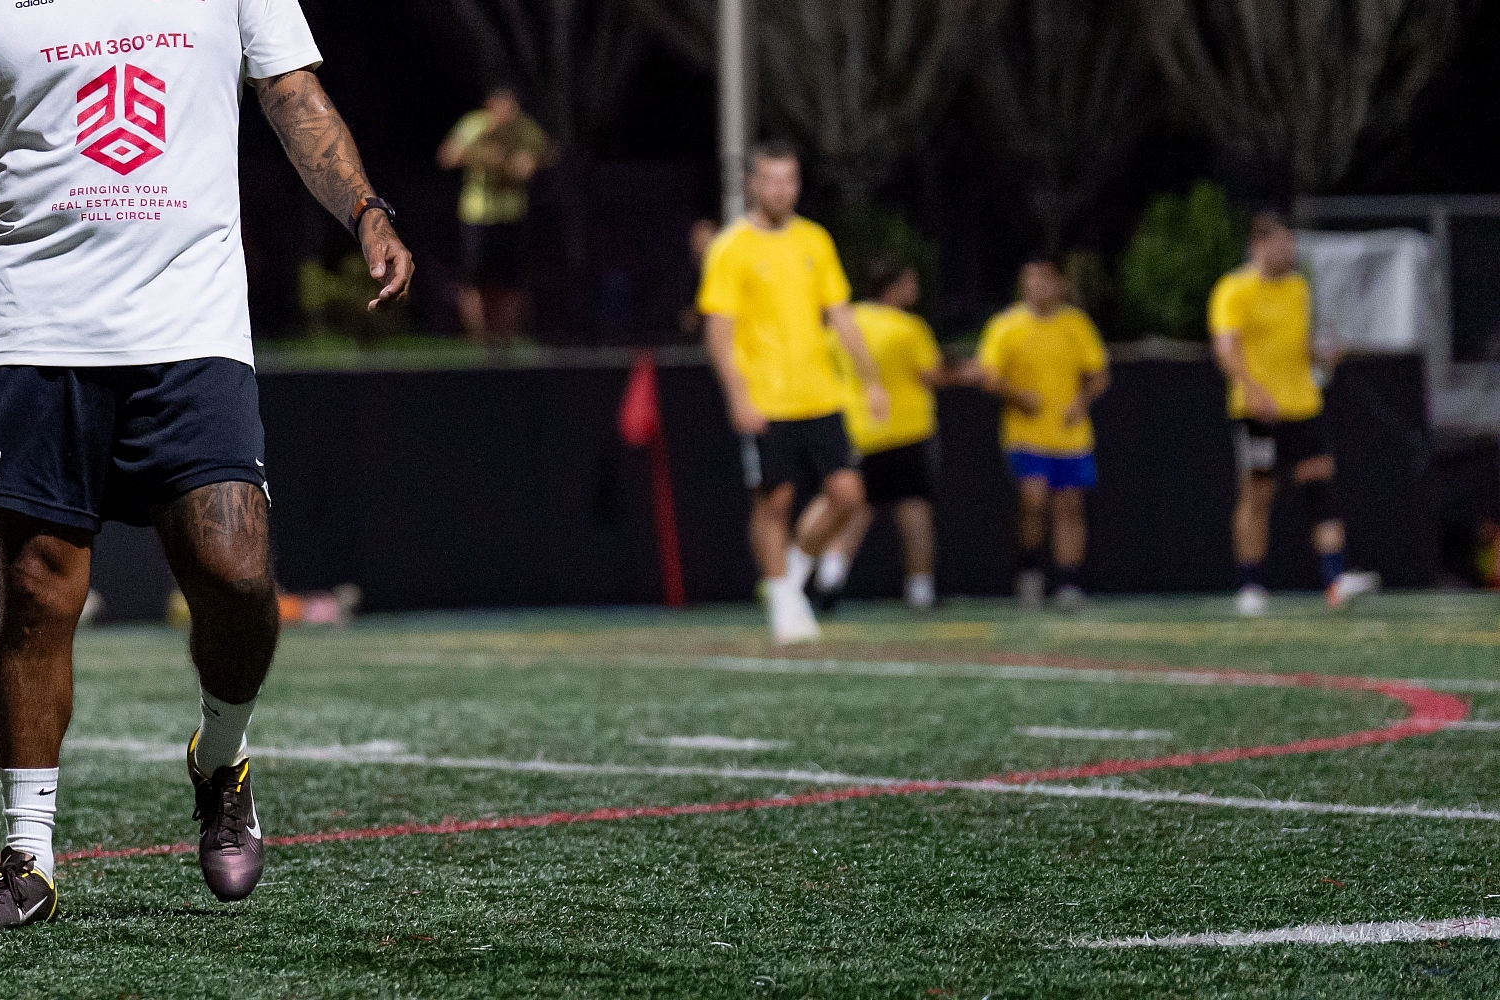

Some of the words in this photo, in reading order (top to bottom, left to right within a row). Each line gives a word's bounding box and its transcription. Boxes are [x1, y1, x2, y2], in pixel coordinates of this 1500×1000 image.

[40, 40, 102, 63] TEAM
[69, 185, 130, 197] BRINGING
[135, 185, 168, 194] YOUR
[51, 201, 81, 211] REAL
[86, 199, 134, 208] ESTATE
[140, 199, 188, 209] DREAMS
[80, 212, 111, 221] FULL
[116, 211, 161, 220] CIRCLE
